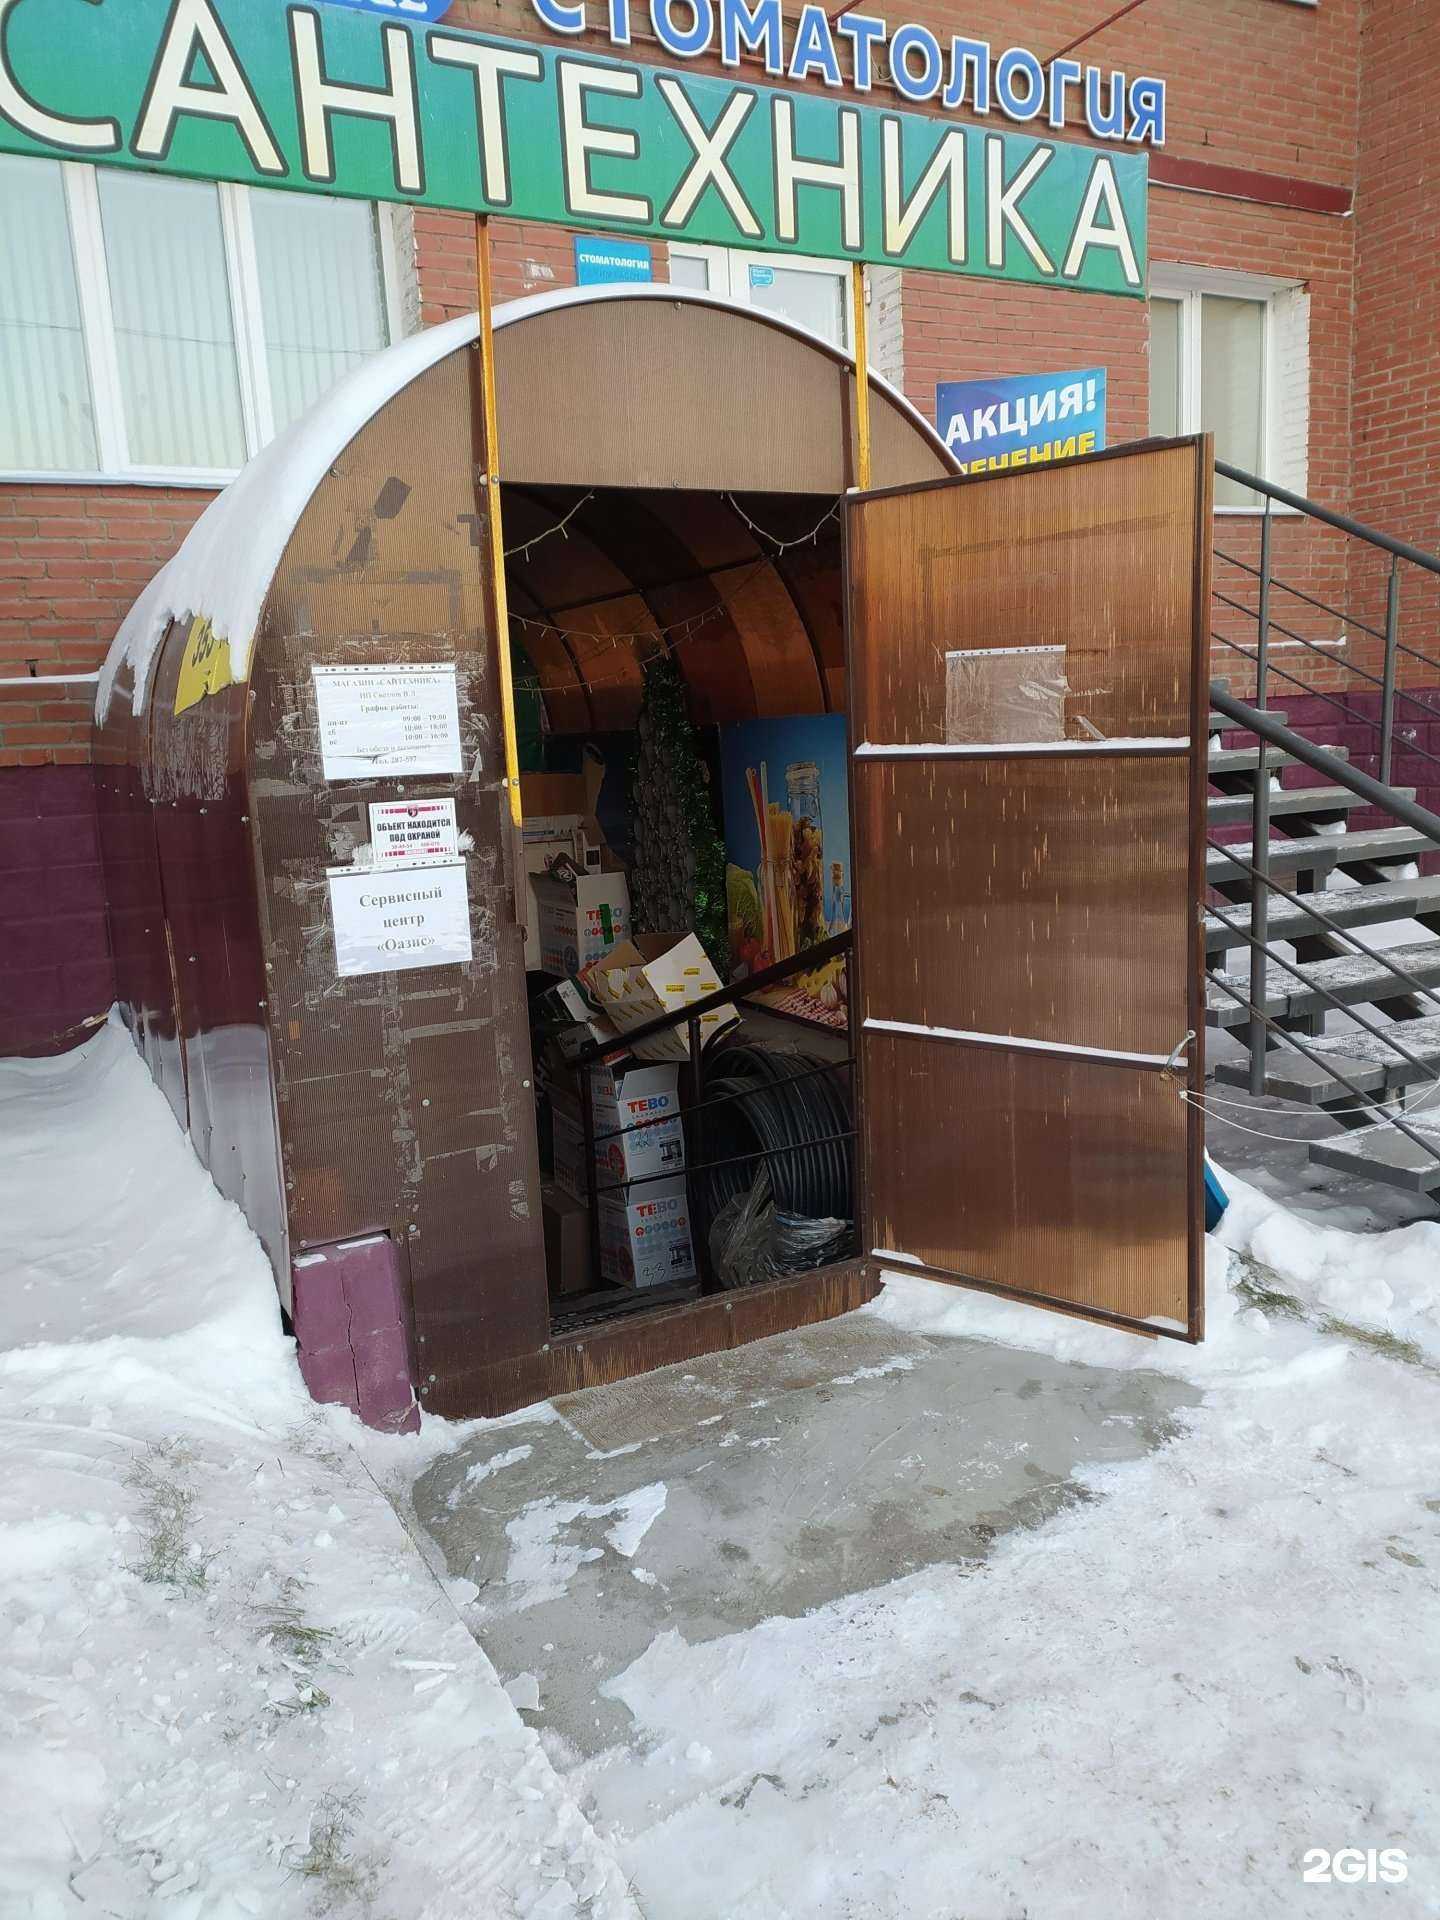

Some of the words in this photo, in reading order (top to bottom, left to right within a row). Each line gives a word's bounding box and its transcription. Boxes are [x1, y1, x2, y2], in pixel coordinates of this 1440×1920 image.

[0, 0, 1143, 288] САНТЕХНИКА
[579, 253, 650, 271] СТОМАТОЛОГИЯ
[945, 378, 1096, 447] АКЦИЯ!
[960, 431, 1096, 474] ЕЧЕНИЕ
[377, 821, 405, 831] ОБЪЕКТ
[407, 818, 451, 829] НАХОДИТСЯ
[389, 833, 406, 842] ПОД
[407, 829, 440, 841] ОХРАНОЙ
[360, 887, 442, 908] Сервисный
[383, 914, 425, 928] центр
[377, 936, 435, 952] «Оазис»
[627, 1095, 669, 1113] TEBO
